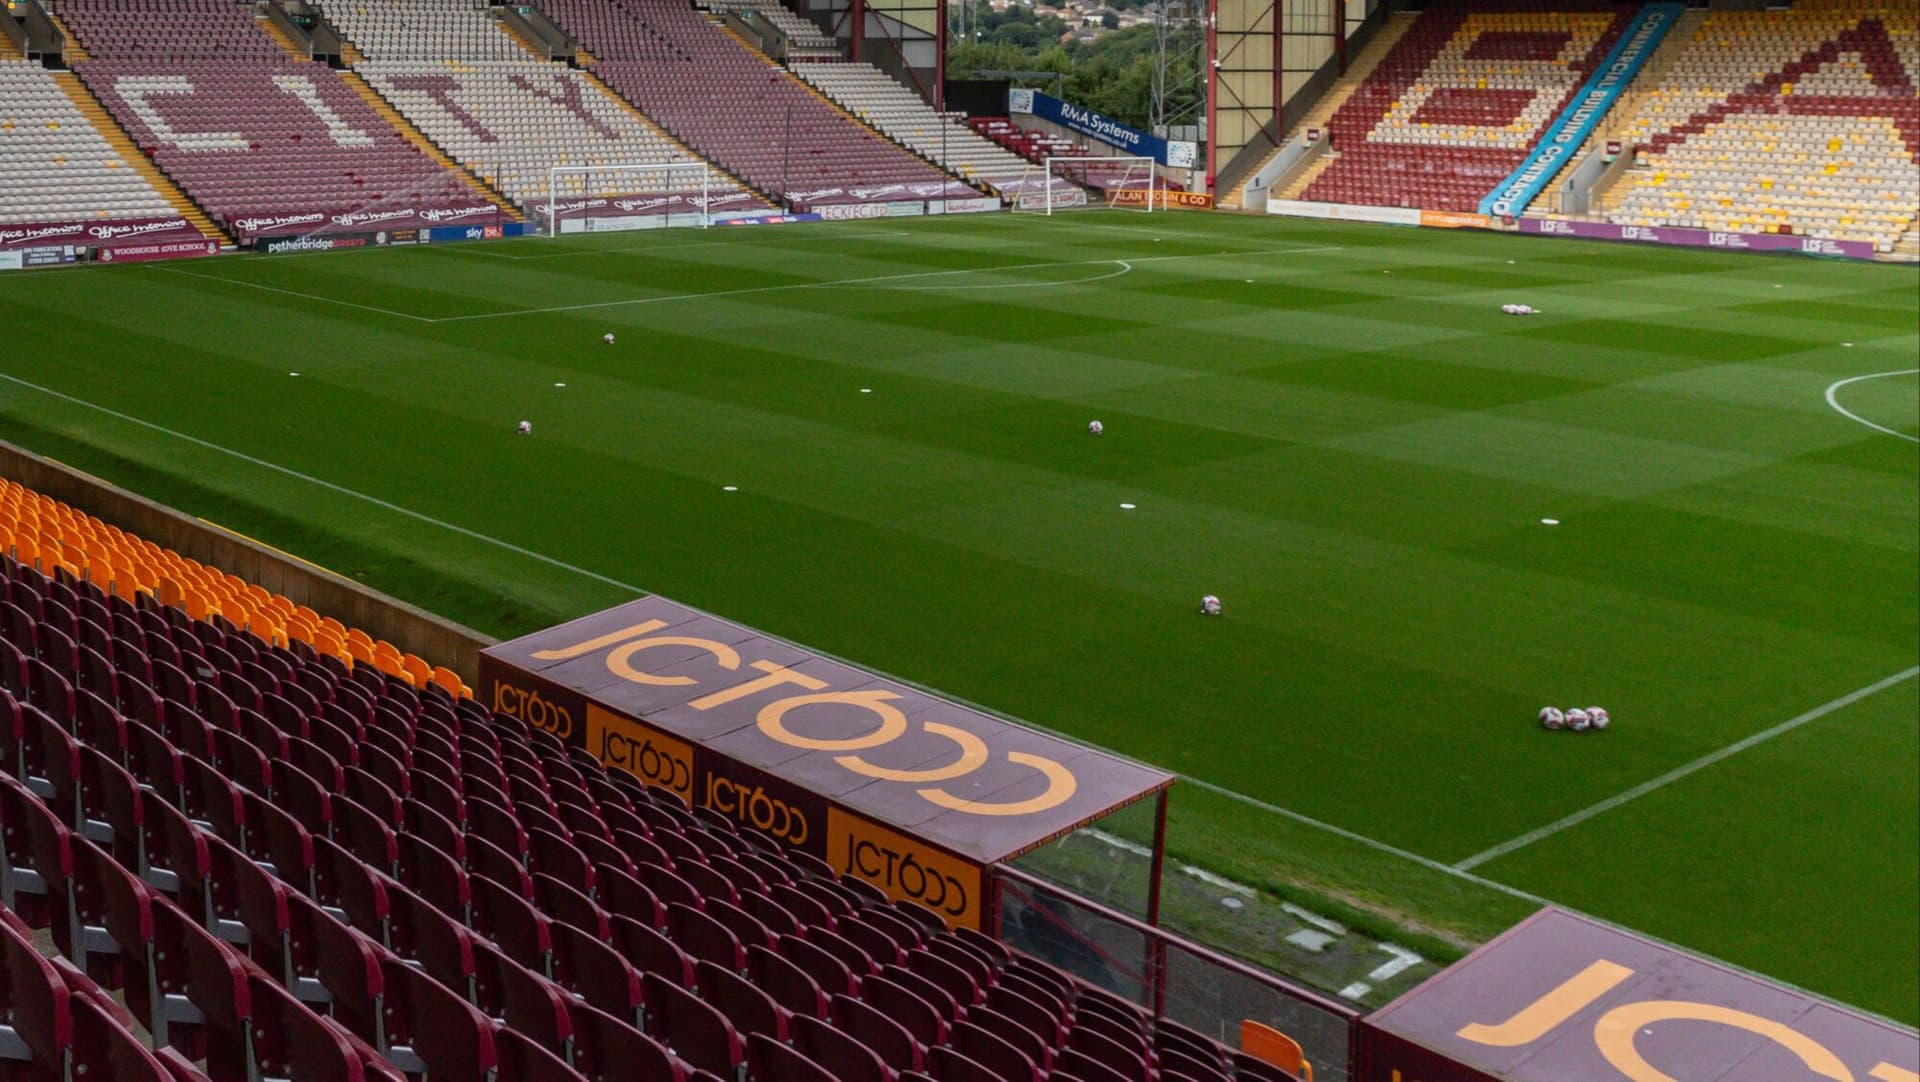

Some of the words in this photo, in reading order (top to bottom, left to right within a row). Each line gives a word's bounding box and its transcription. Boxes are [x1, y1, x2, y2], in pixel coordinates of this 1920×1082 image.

[114, 75, 620, 151] CITY
[1060, 103, 1089, 126] RMA
[1091, 113, 1140, 144] Systems
[1555, 90, 1608, 143] BUILDING
[1190, 196, 1206, 207] CO
[114, 244, 160, 256] WOODHOUSE
[179, 242, 206, 252] SCHOOL
[466, 226, 483, 240] sky
[1456, 959, 1919, 1082] JC
